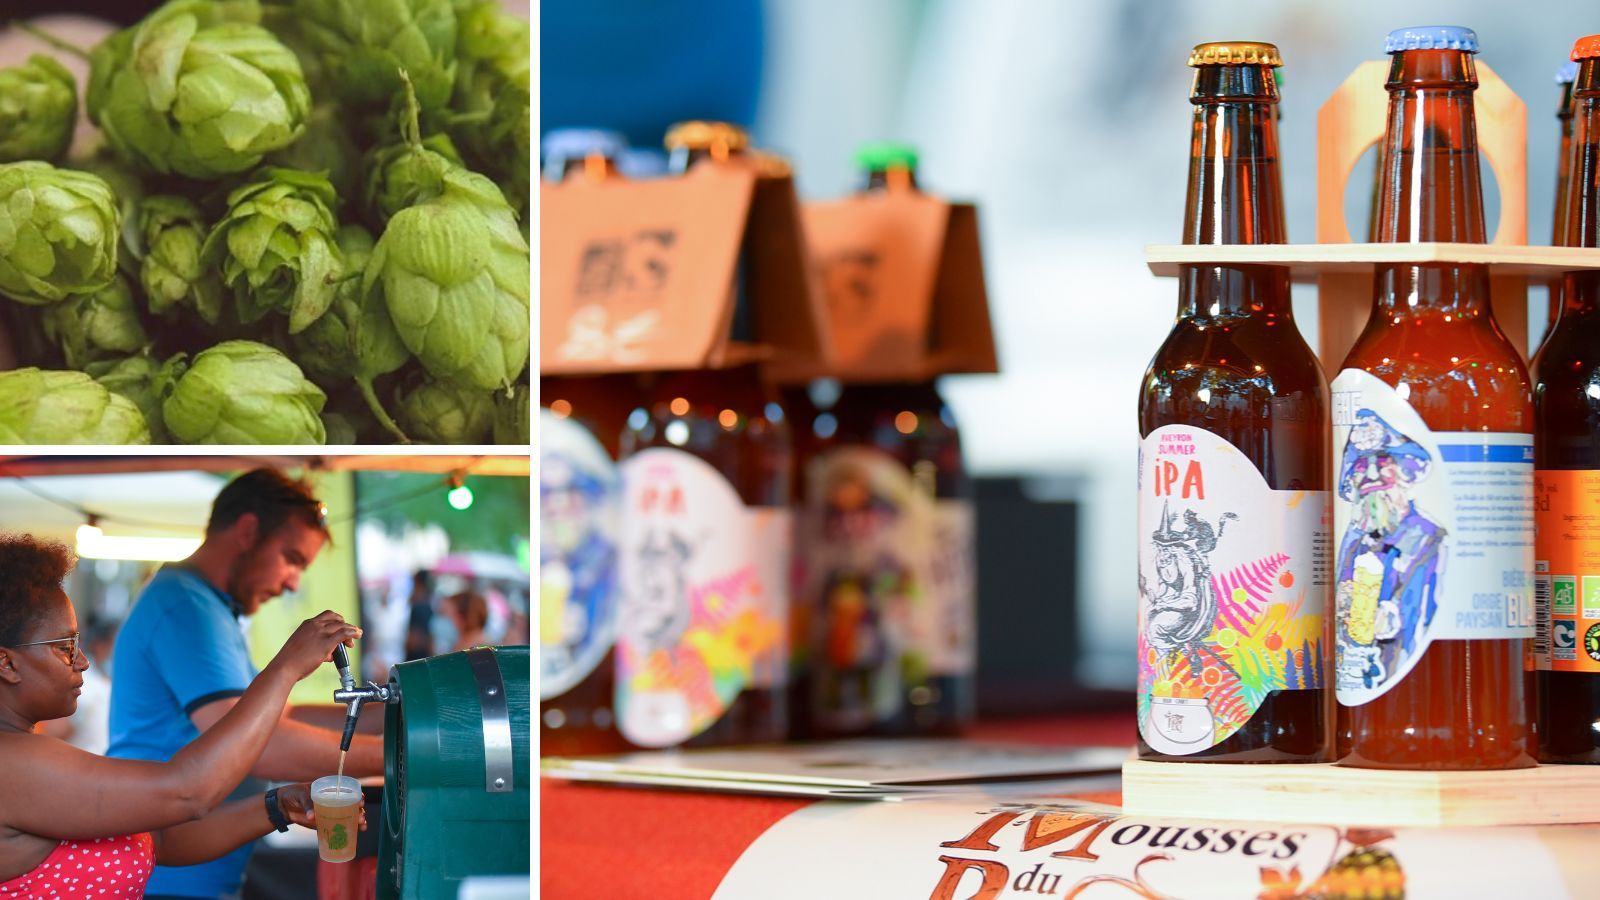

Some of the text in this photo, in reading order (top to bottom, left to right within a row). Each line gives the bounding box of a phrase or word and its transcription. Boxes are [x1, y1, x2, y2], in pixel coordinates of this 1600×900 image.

[1158, 444, 1196, 455] SUMMER
[1473, 593, 1503, 610] ORGE
[1456, 611, 1503, 628] PAYSAN
[939, 808, 1307, 862] Mousses
[1013, 863, 1063, 895] du
